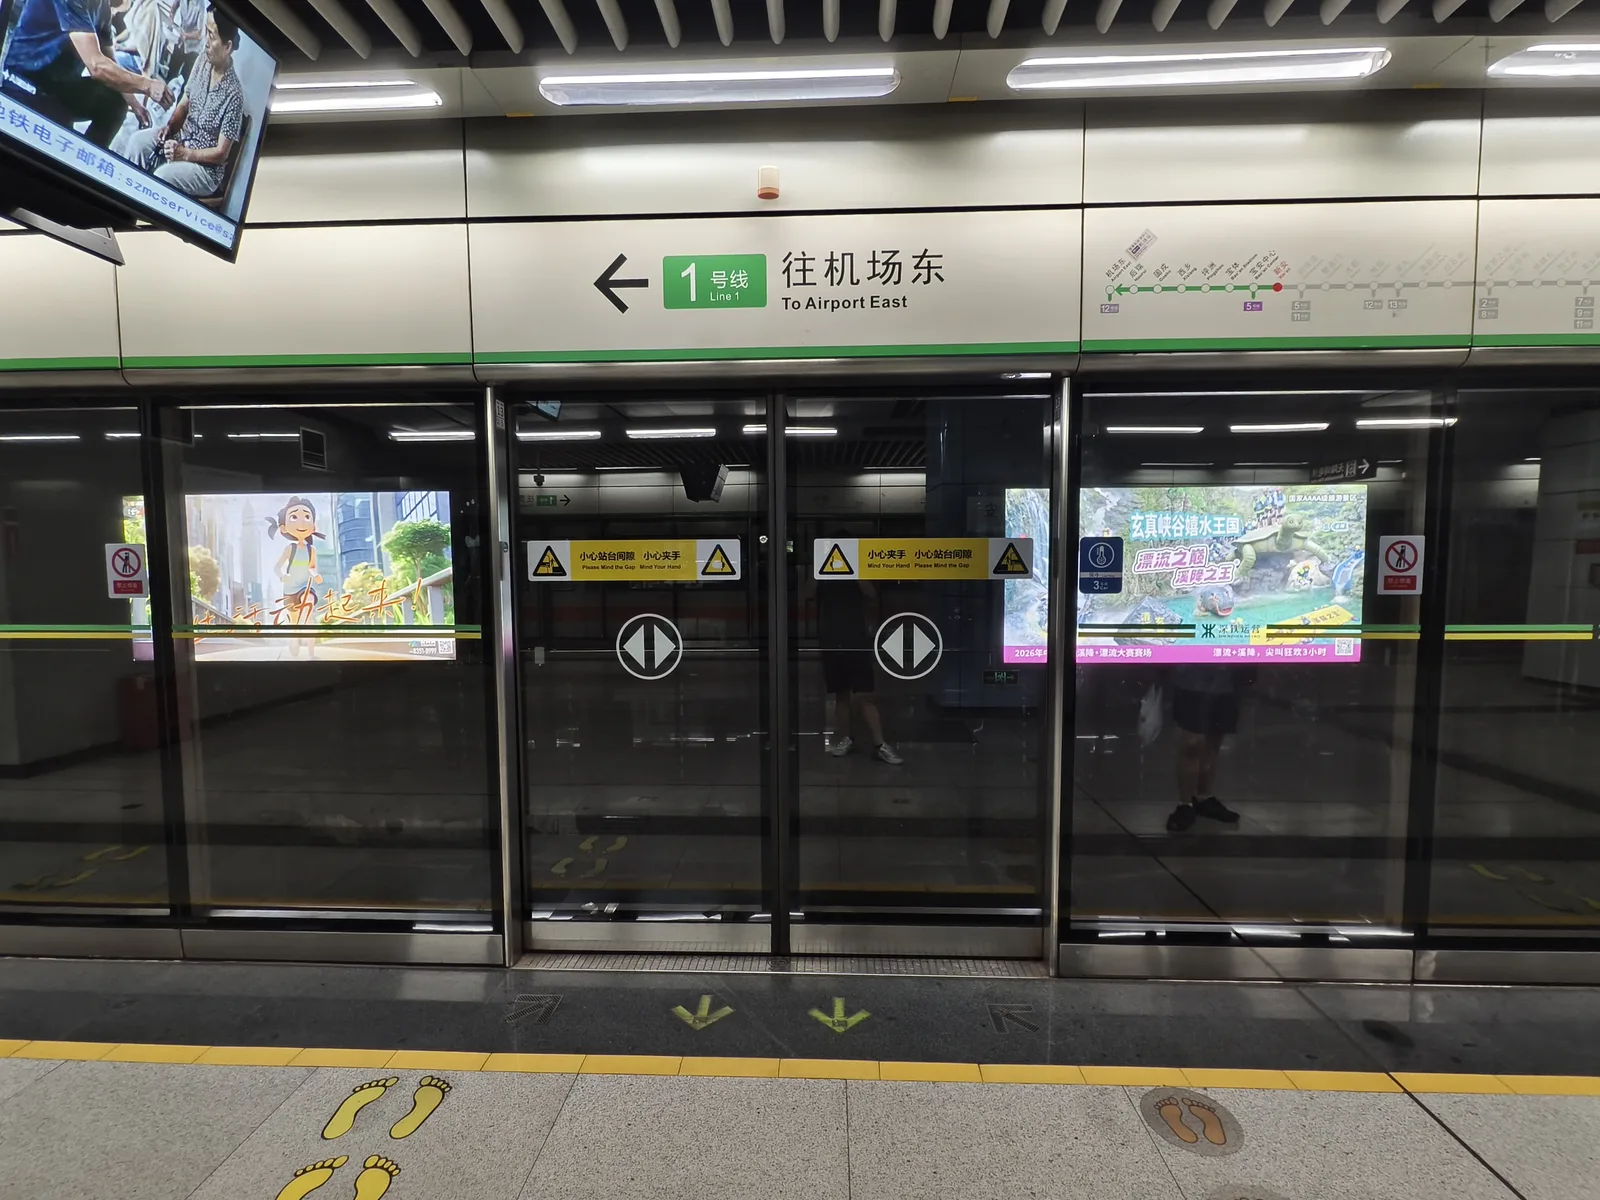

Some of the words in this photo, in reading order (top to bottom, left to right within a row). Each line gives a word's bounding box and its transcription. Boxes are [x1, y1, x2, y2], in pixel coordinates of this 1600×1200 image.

[782, 248, 945, 288] 往机场东
[1106, 258, 1125, 277] 机场东
[681, 262, 696, 302] 1
[710, 270, 749, 289] 号线
[710, 292, 732, 302] Line
[734, 292, 740, 302] 1
[782, 297, 801, 311] To
[805, 296, 866, 312] Airport
[870, 295, 908, 309] East
[1130, 514, 1240, 538] 玄真峡谷嬉水王国
[580, 552, 635, 561] 小心站台间隙
[643, 551, 680, 561] 小心夹手
[868, 550, 906, 559] 小心夹手
[914, 550, 972, 559] 小心站台间隙
[1176, 566, 1232, 583] 溪降之王
[1093, 580, 1100, 590] 3
